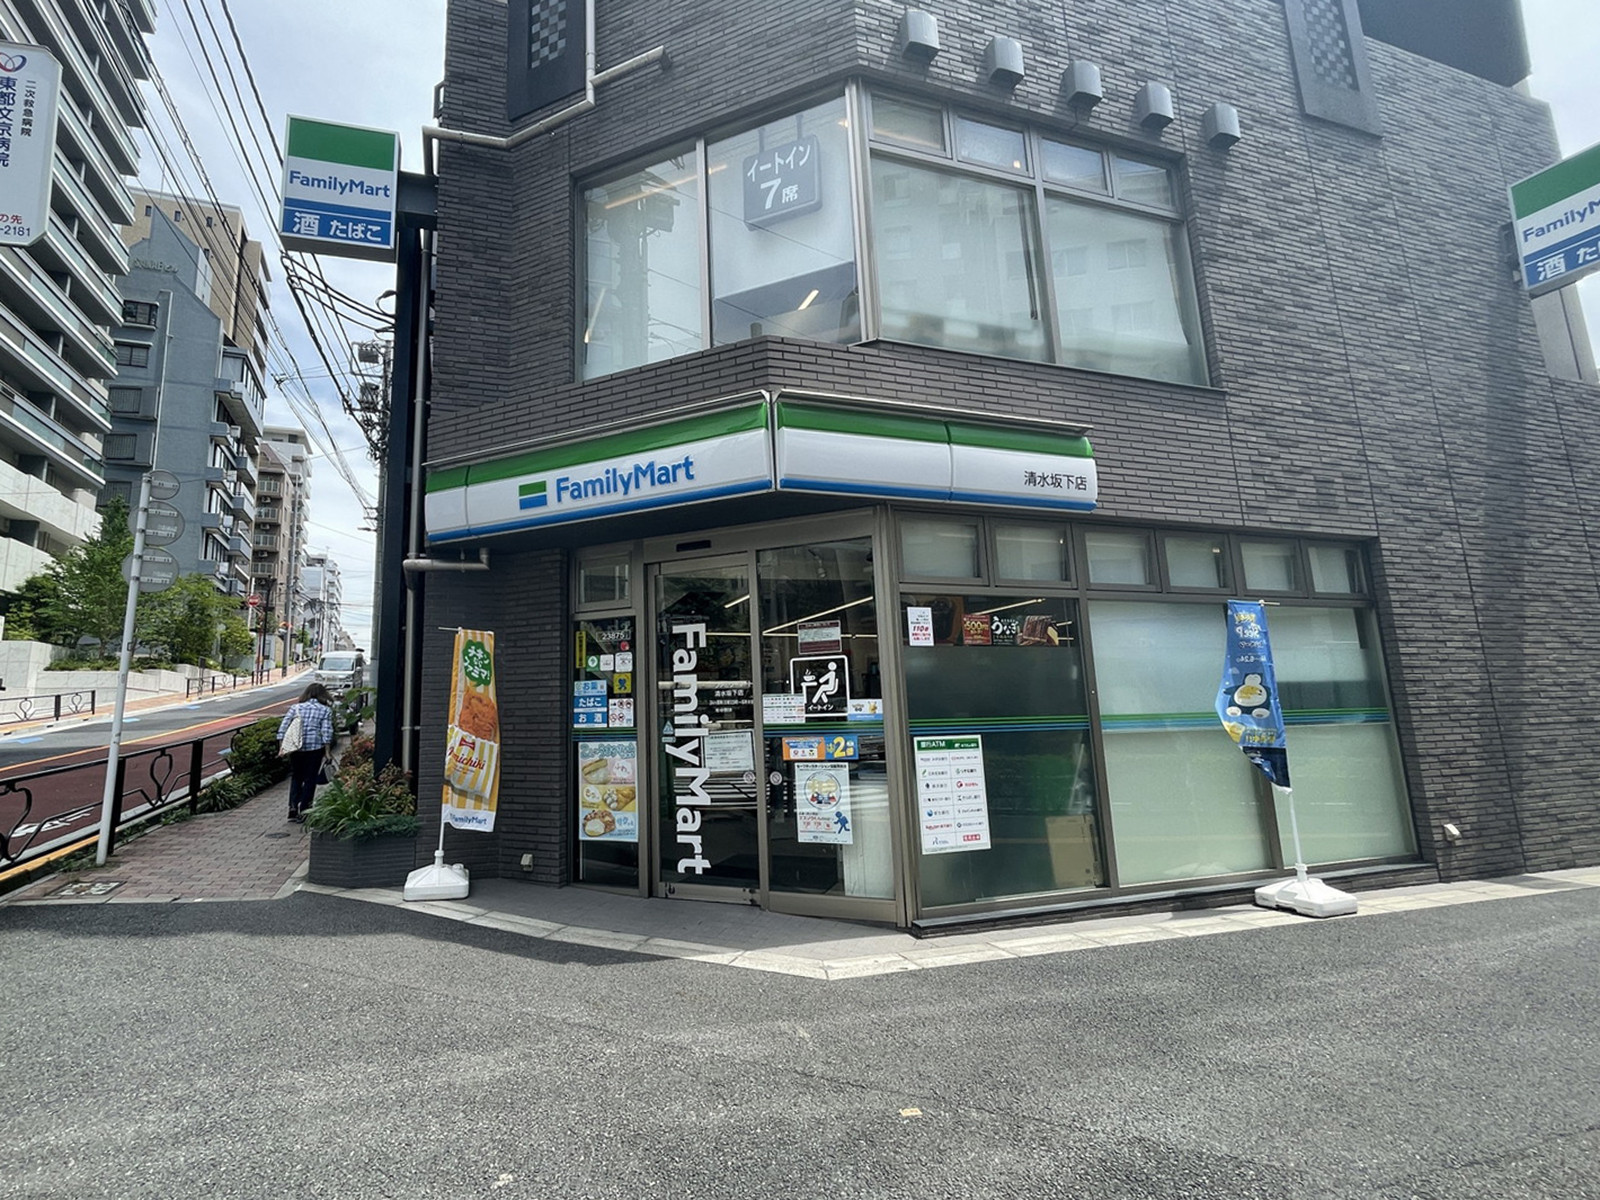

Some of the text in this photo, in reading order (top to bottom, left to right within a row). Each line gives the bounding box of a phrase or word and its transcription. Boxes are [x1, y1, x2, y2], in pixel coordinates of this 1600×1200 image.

[20, 80, 36, 137] 二次救急病院
[747, 145, 811, 182] イートイン
[289, 169, 391, 198] FamilyMart
[292, 211, 382, 241] 酒 たばこ
[1536, 241, 1600, 282] 酒 た
[556, 455, 695, 503] FamilyMart
[1024, 470, 1087, 491] 清水坂下店
[808, 703, 834, 711] イートイン
[665, 622, 711, 875] FamilyMart
